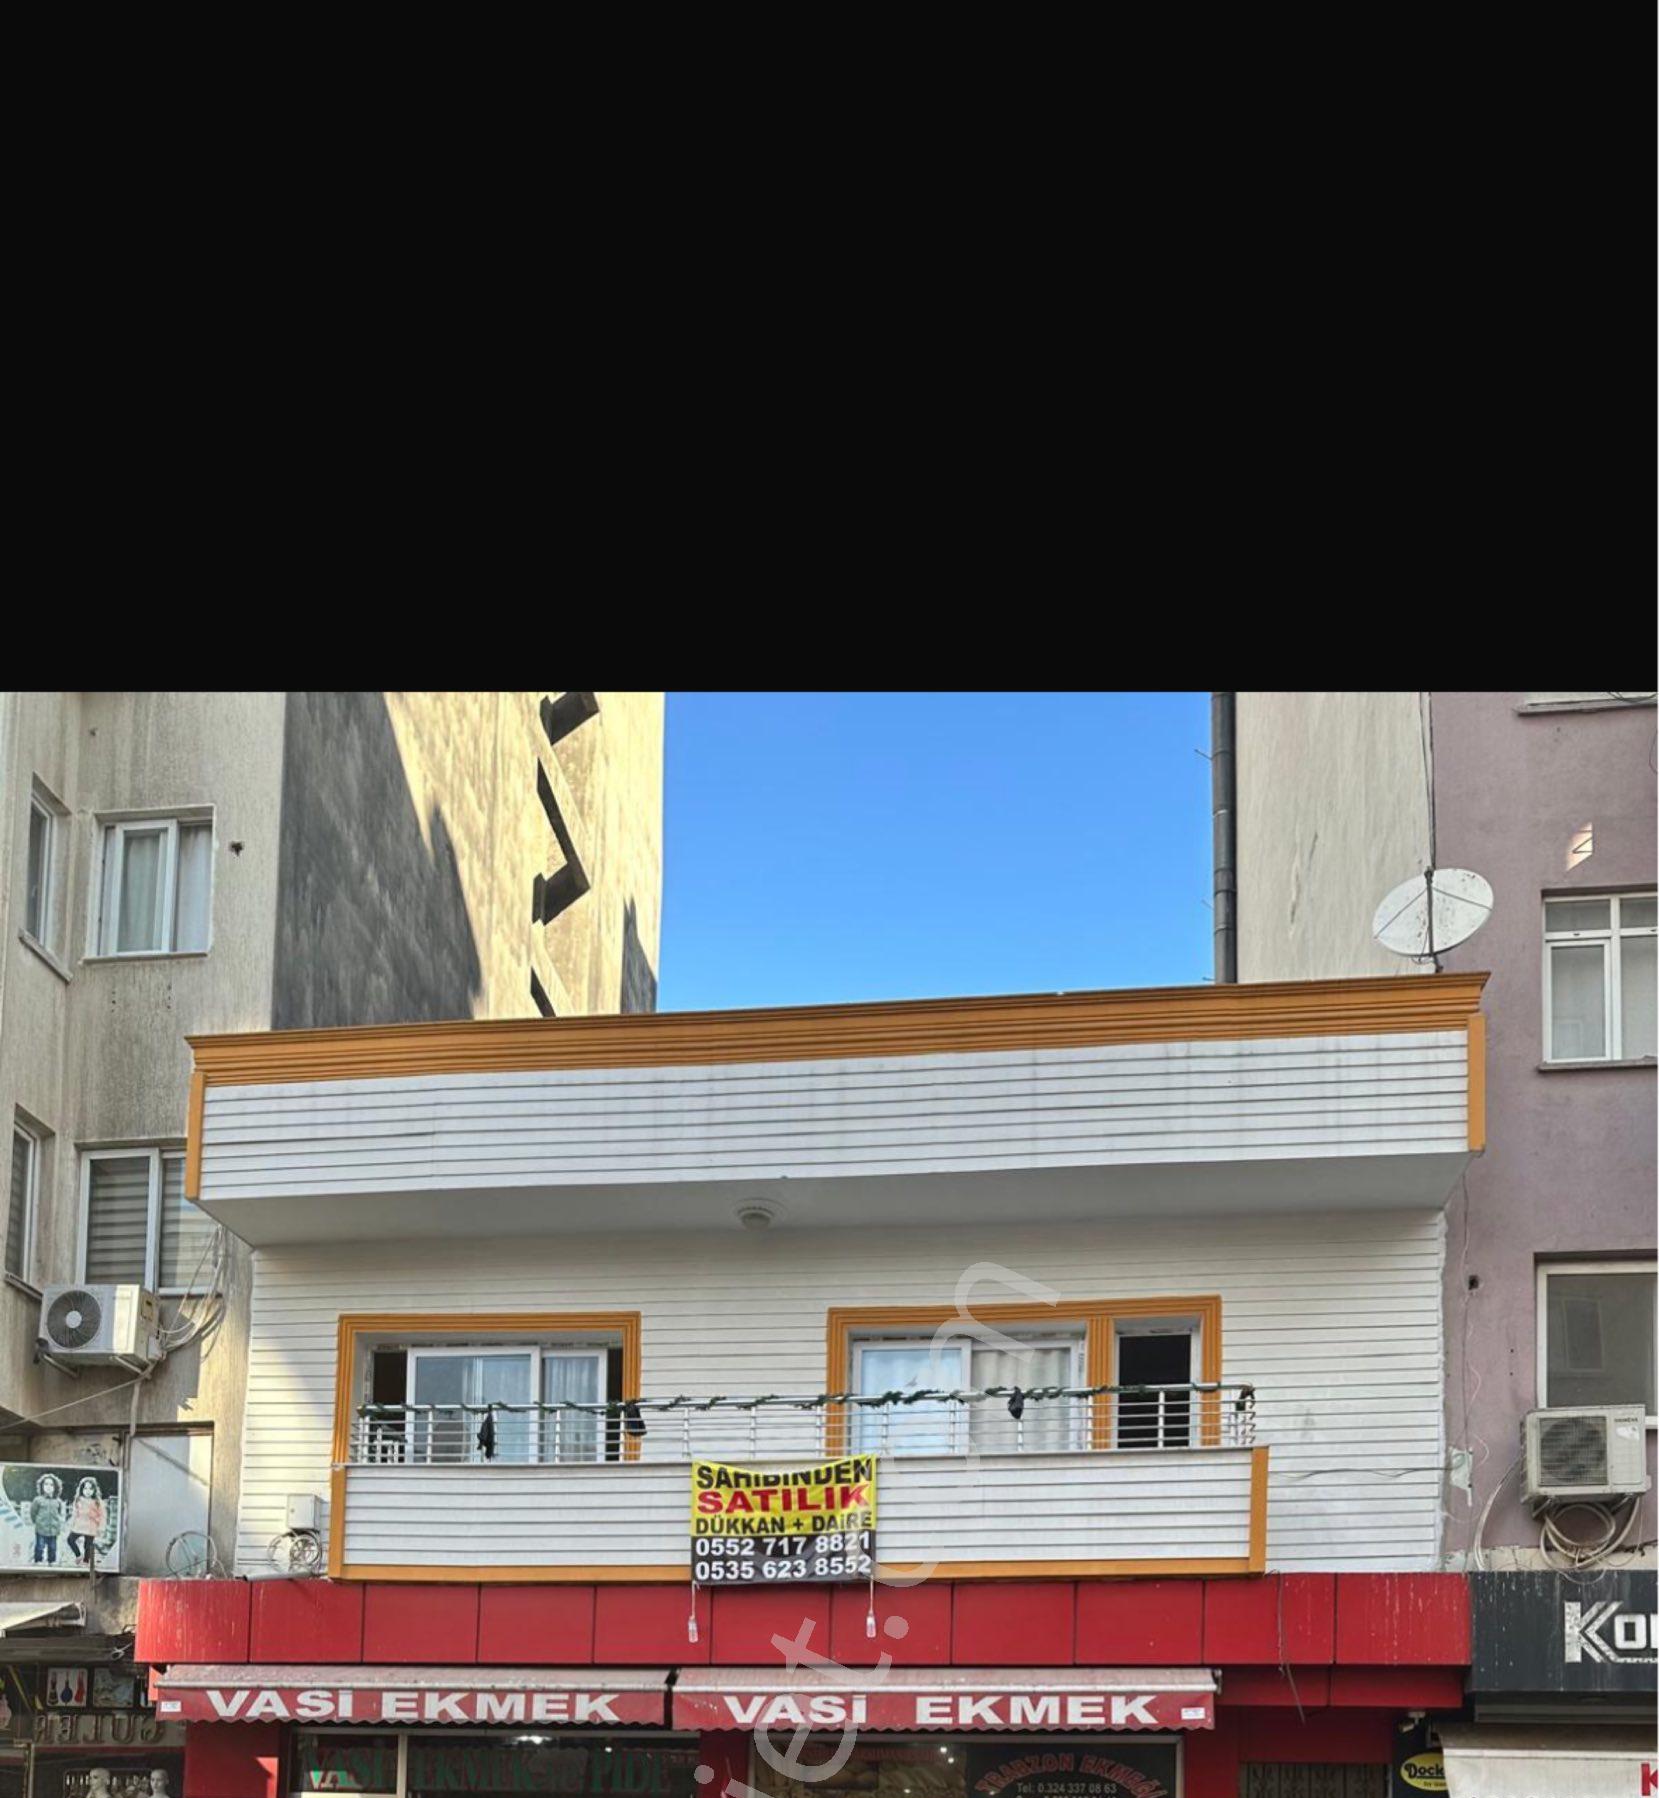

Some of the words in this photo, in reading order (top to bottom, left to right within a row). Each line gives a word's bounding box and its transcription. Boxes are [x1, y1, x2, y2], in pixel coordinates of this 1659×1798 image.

[697, 1484, 870, 1514] SATILIK
[696, 1514, 785, 1535] DÜKKAN
[696, 1538, 755, 1556] 0552
[763, 1537, 806, 1555] 717
[815, 1531, 870, 1551] 8821
[695, 1560, 754, 1580] 0535
[762, 1560, 807, 1579] 623
[814, 1555, 872, 1576] 8552
[381, 1692, 620, 1722] EKMEK
[915, 1695, 1158, 1725] EKMEK
[974, 1752, 1075, 1794] TRABZON
[1404, 1763, 1446, 1779] Dock
